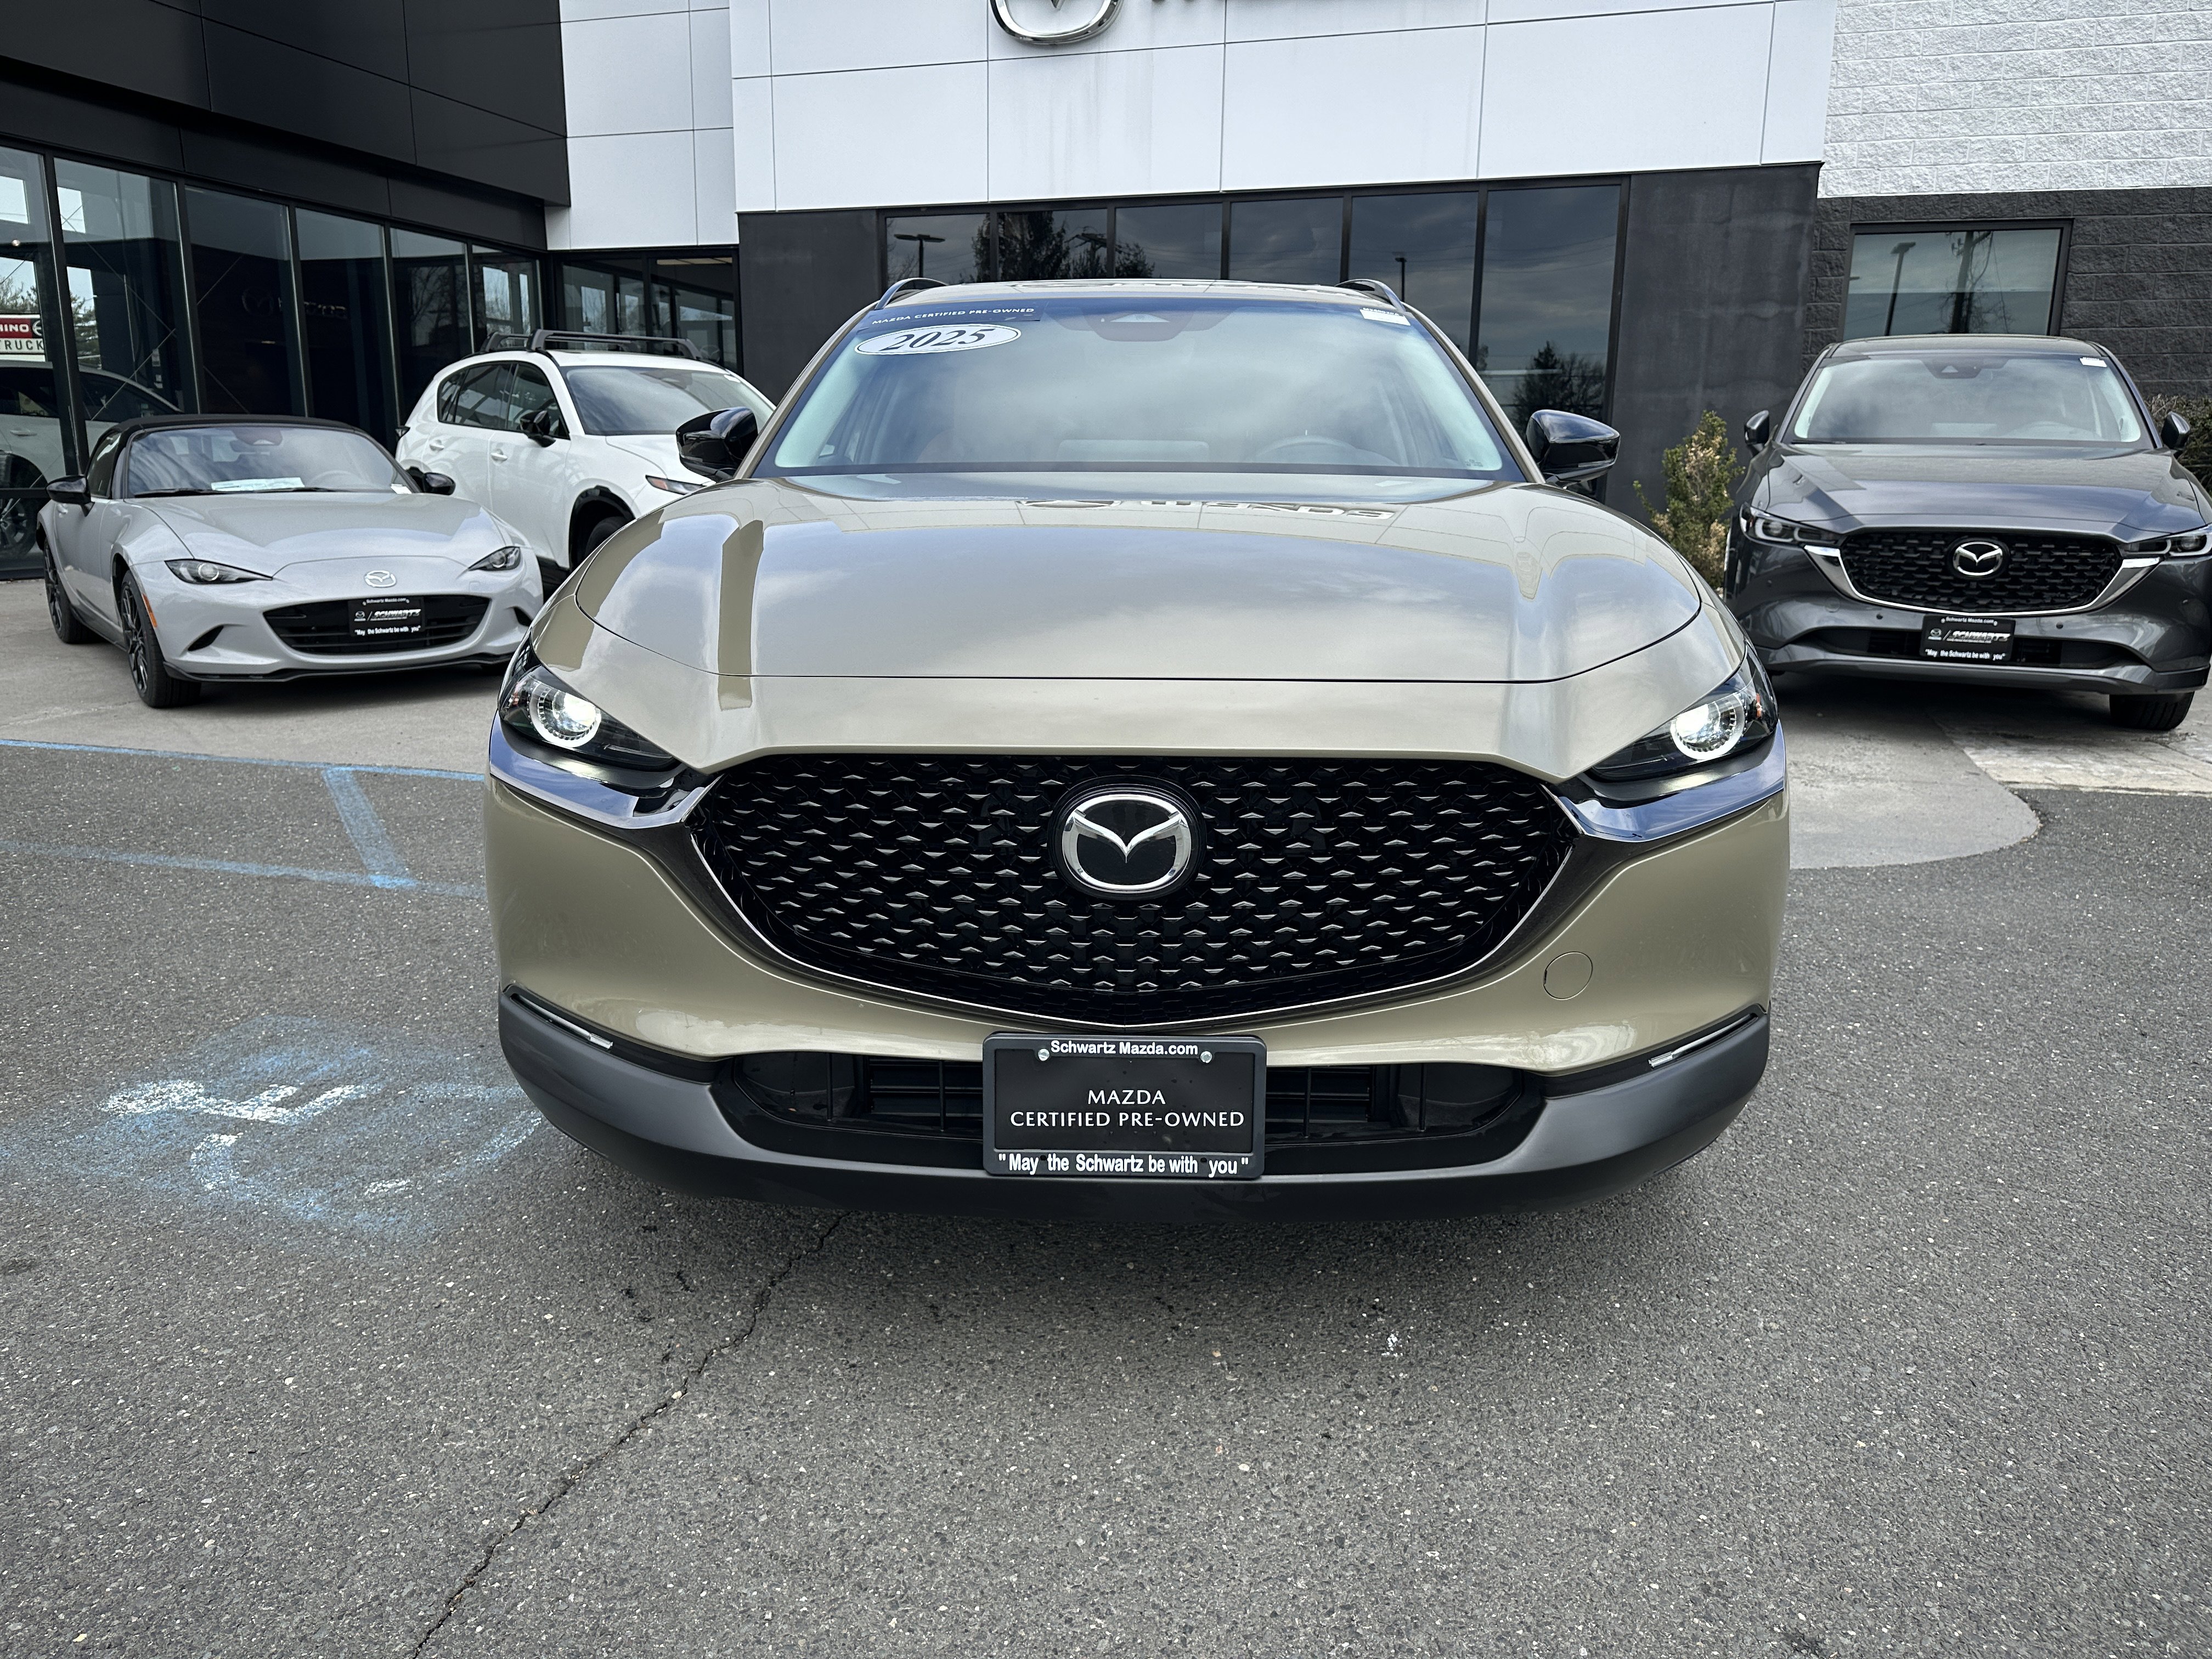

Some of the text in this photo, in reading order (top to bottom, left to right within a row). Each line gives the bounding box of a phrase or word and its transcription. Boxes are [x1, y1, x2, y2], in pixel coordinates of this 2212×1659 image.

[872, 315, 911, 325] MAZDA
[914, 311, 966, 319] CERTIFIED
[0, 340, 44, 351] RUCK
[879, 329, 994, 351] 2025
[1051, 1040, 1198, 1056] Schwartz Mazda.com
[1087, 1090, 1166, 1105] MAZDA
[1010, 1111, 1245, 1127] CERTIFIED PRE-OWNED
[1047, 1153, 1069, 1172] the
[1075, 1153, 1144, 1173] Schwartz
[1148, 1154, 1165, 1173] be
[1169, 1155, 1198, 1174] with
